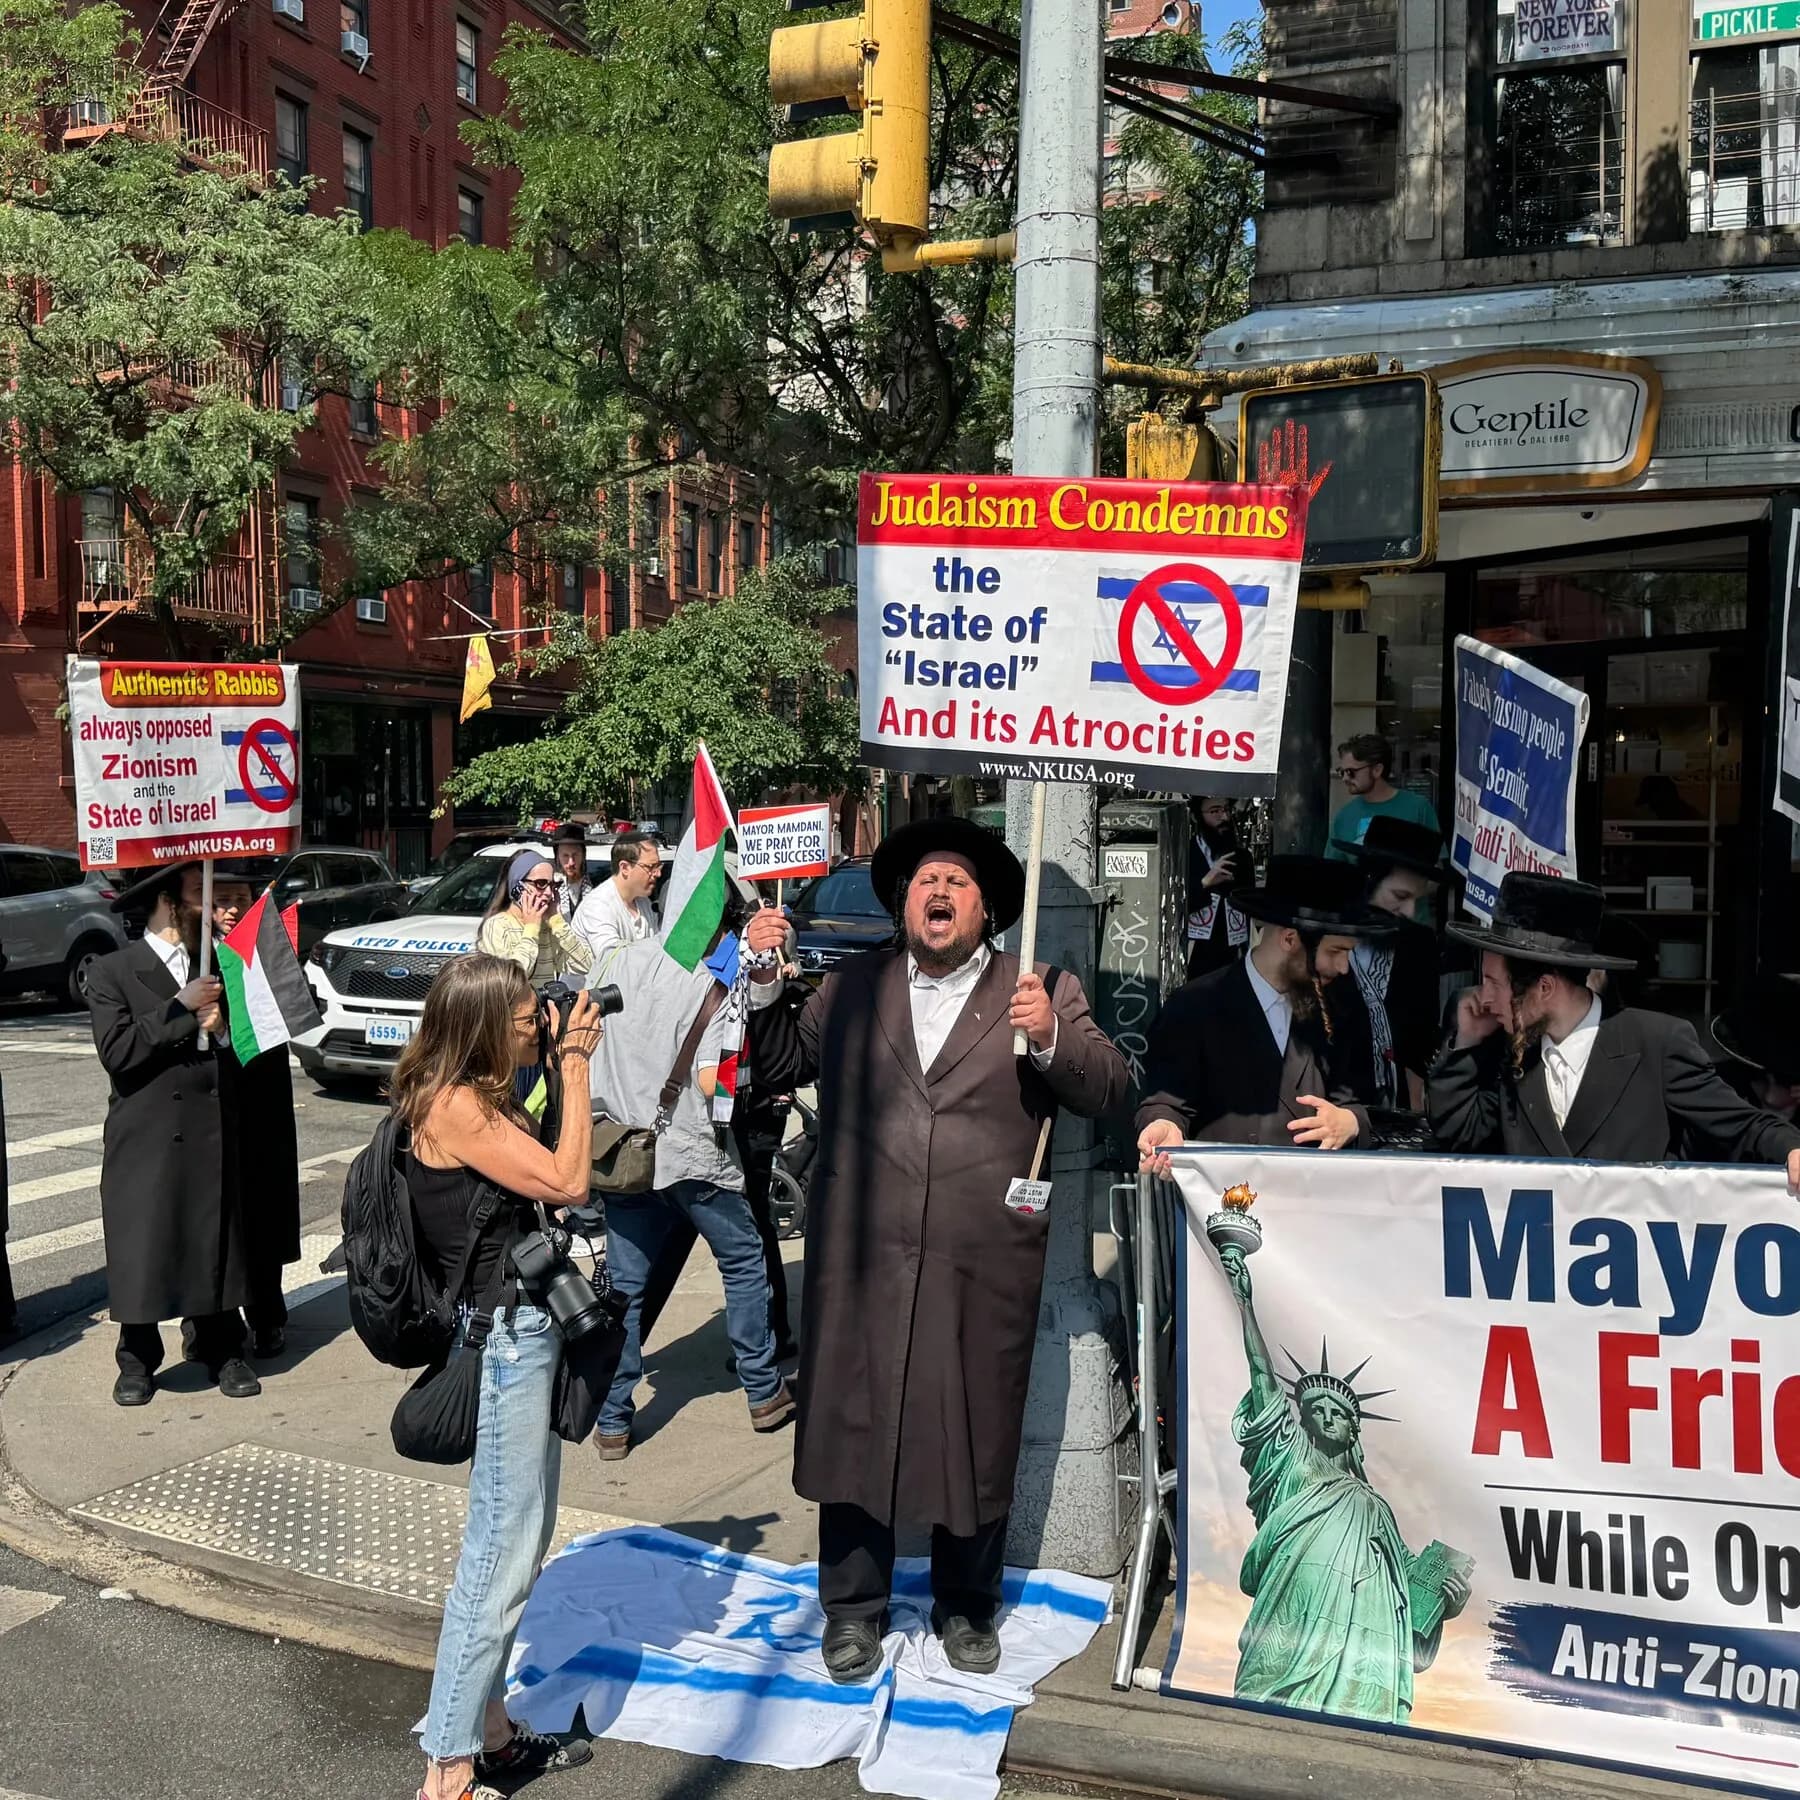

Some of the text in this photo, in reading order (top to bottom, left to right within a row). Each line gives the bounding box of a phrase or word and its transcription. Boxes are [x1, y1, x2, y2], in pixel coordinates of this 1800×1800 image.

[1518, 0, 1557, 19] NEW
[1711, 7, 1778, 39] PICKLE
[1517, 11, 1610, 47] FOREVER
[1450, 397, 1590, 446] Gentile
[871, 481, 1289, 540] Judaism Condemns
[933, 556, 1001, 595] the
[881, 602, 1048, 644] State of
[111, 668, 279, 697] Authentic Rabbis
[885, 650, 1039, 691] “Israel”
[80, 713, 213, 746] always opposed
[877, 696, 1255, 762] And its Atrocities
[1526, 712, 1565, 760] people
[102, 753, 198, 780] Zionism
[978, 760, 1136, 788] www.NKUSA.org
[133, 782, 176, 799] and the
[88, 796, 217, 830] State of Israel
[742, 823, 774, 836] MAYOR
[152, 836, 276, 859] www.NKUSA.org
[741, 848, 825, 866] YOUR SUCCESS!
[745, 835, 821, 851] WE PRAY FOR
[351, 936, 472, 952] NYPD POLICE
[369, 1026, 397, 1039] 4559
[1441, 1186, 1800, 1337] Mayo
[1471, 1324, 1554, 1459] A
[1499, 1505, 1800, 1624] While Op
[1551, 1623, 1800, 1711] Anti-Zion
